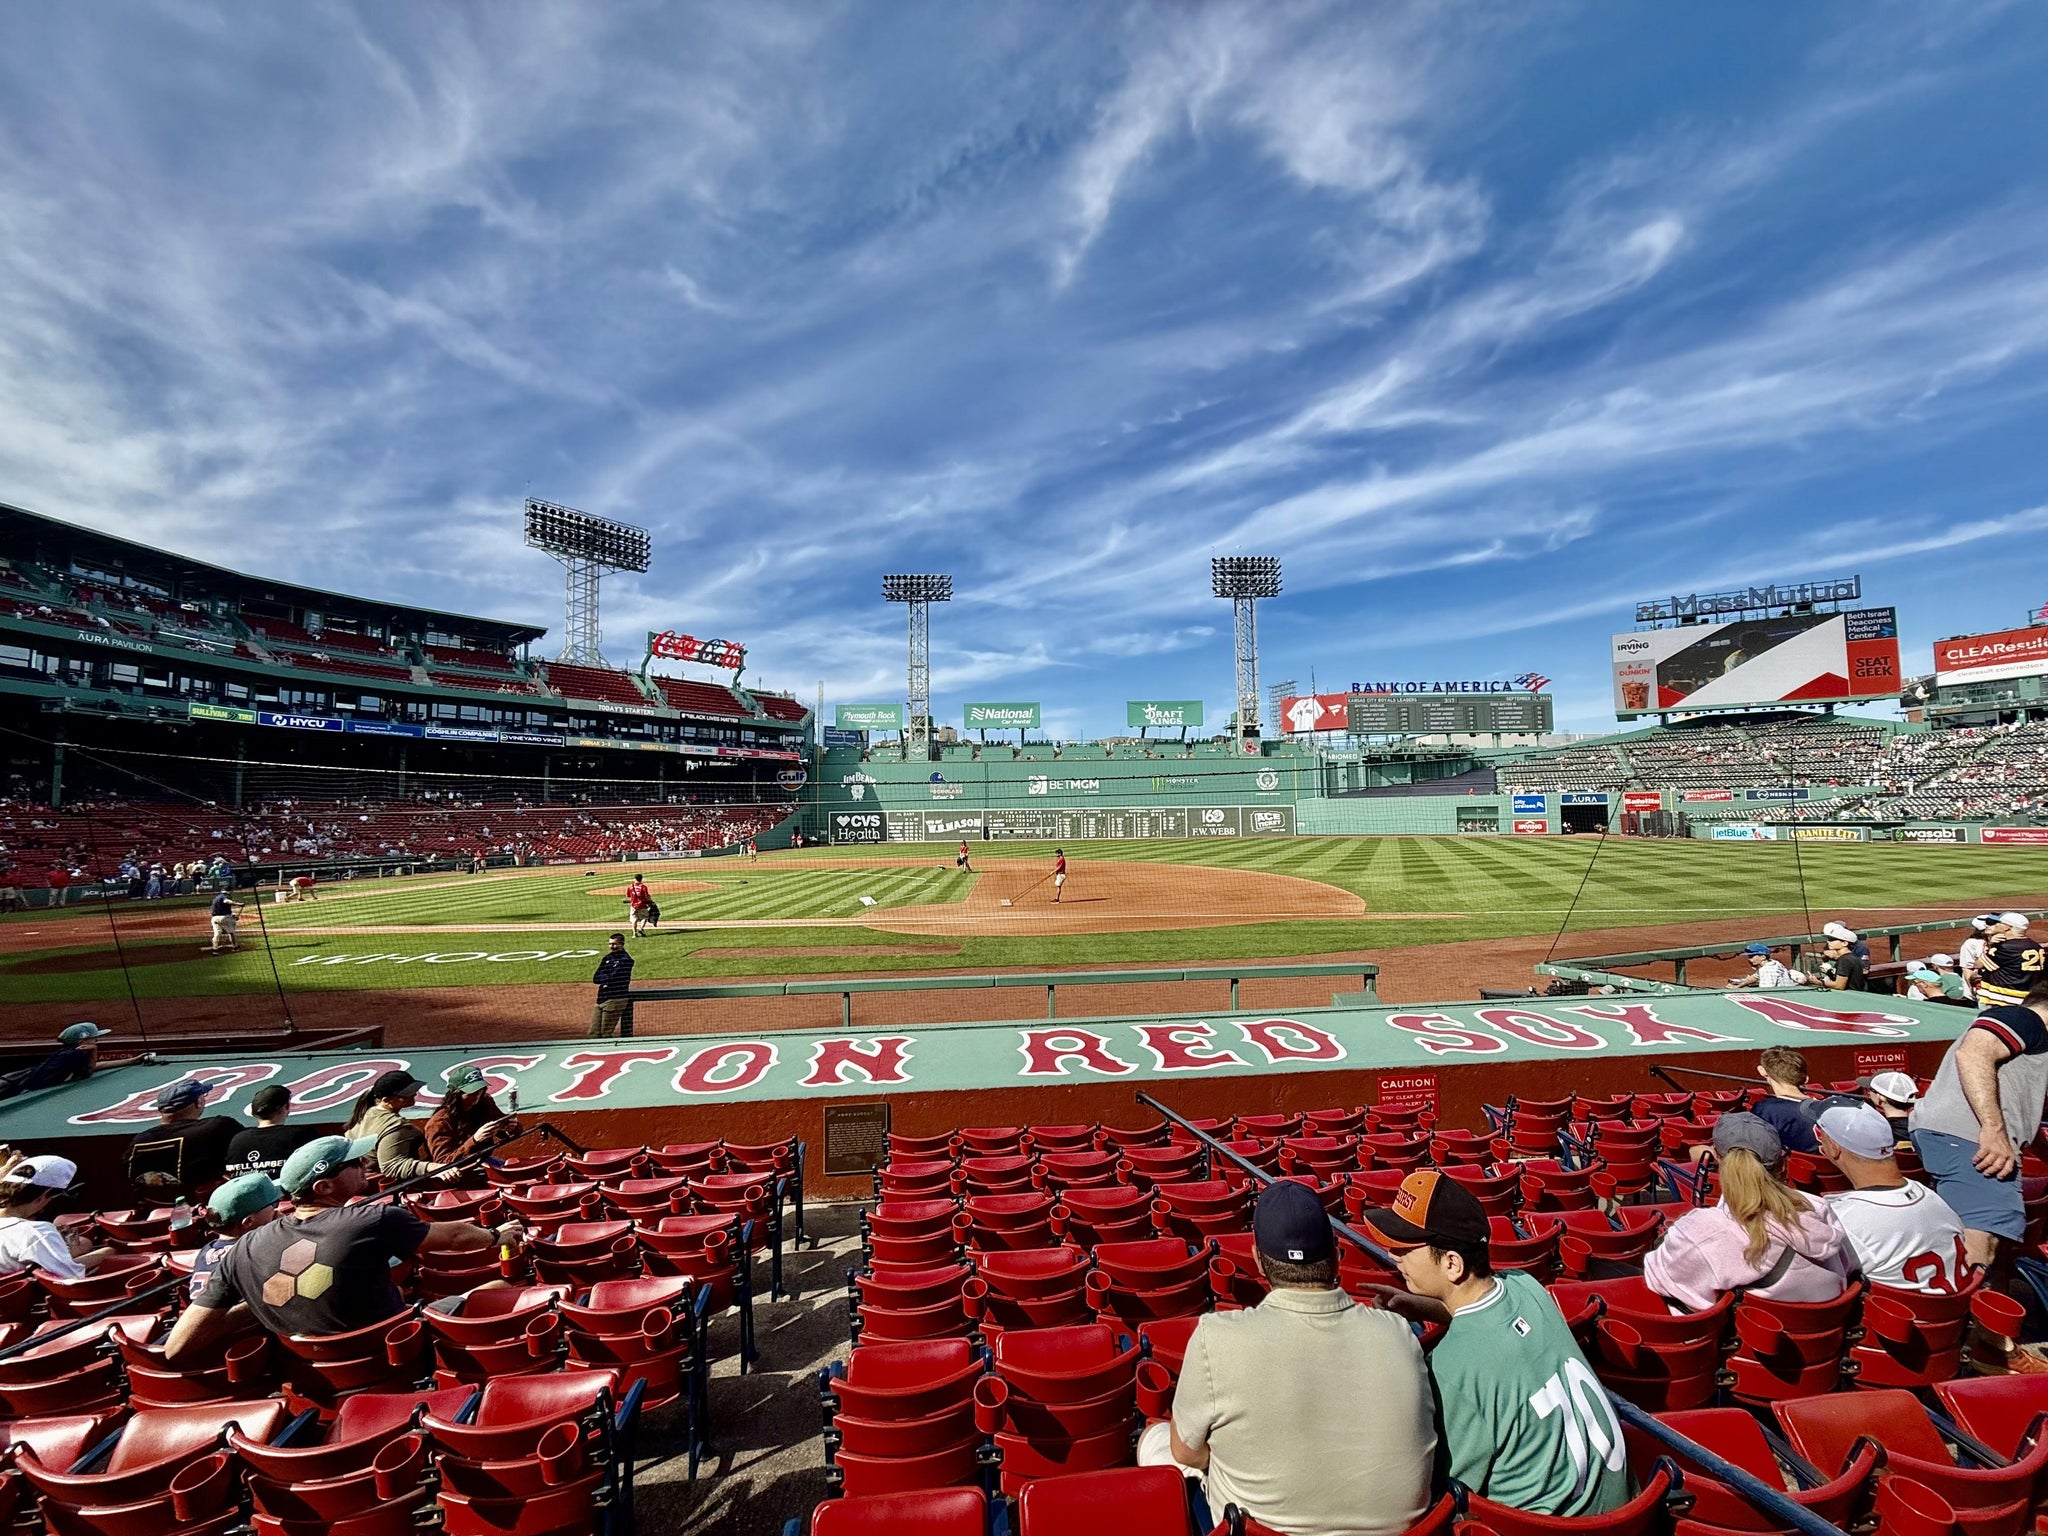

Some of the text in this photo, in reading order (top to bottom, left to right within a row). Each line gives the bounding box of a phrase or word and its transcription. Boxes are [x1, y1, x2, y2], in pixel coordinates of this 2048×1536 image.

[1671, 575, 1861, 616] MassMutual
[1847, 610, 1890, 620] Beth Israel
[1847, 617, 1892, 626] Deaconess
[1848, 624, 1881, 633] Medical
[1848, 632, 1876, 640] Center
[112, 639, 152, 652] PAVILION
[1617, 642, 1649, 651] IRVING
[1856, 656, 1891, 668] SEAT
[1855, 666, 1893, 678] GEEK
[1352, 681, 1512, 693] BANK OF AMERICA
[192, 706, 253, 721] SULLIVAN TIRE
[598, 704, 655, 716] TODAY'S STARTERS
[985, 708, 1034, 719] National
[1145, 710, 1184, 719] DRAFT
[843, 711, 896, 720] Plymouth Rock
[290, 718, 325, 728] HYCU
[427, 728, 457, 736] COGHLIN
[458, 729, 497, 738] COMPANIES
[508, 735, 542, 743] VINEYARD
[778, 771, 805, 781] Gulf
[1049, 780, 1099, 790] BETMGM
[1703, 792, 1731, 800] TICKET
[851, 815, 881, 827] CVS
[1257, 812, 1281, 822] ACE
[945, 818, 982, 831] MASON
[1258, 820, 1281, 828] TICKET
[838, 828, 880, 840] Health
[1211, 827, 1236, 835] WEBB
[1716, 828, 1748, 838] jetBlue
[1790, 828, 1860, 839] GRANITE CITY
[1904, 829, 1956, 838] wasabi
[100, 889, 128, 897] TICKET
[289, 950, 600, 966] WHOOP
[1017, 1018, 1349, 1077] RED
[1385, 1002, 1756, 1057] SOX
[1858, 1053, 1905, 1063] CAUTION!
[1381, 1078, 1435, 1089] CAUTION!
[1528, 1356, 1626, 1503] 10
